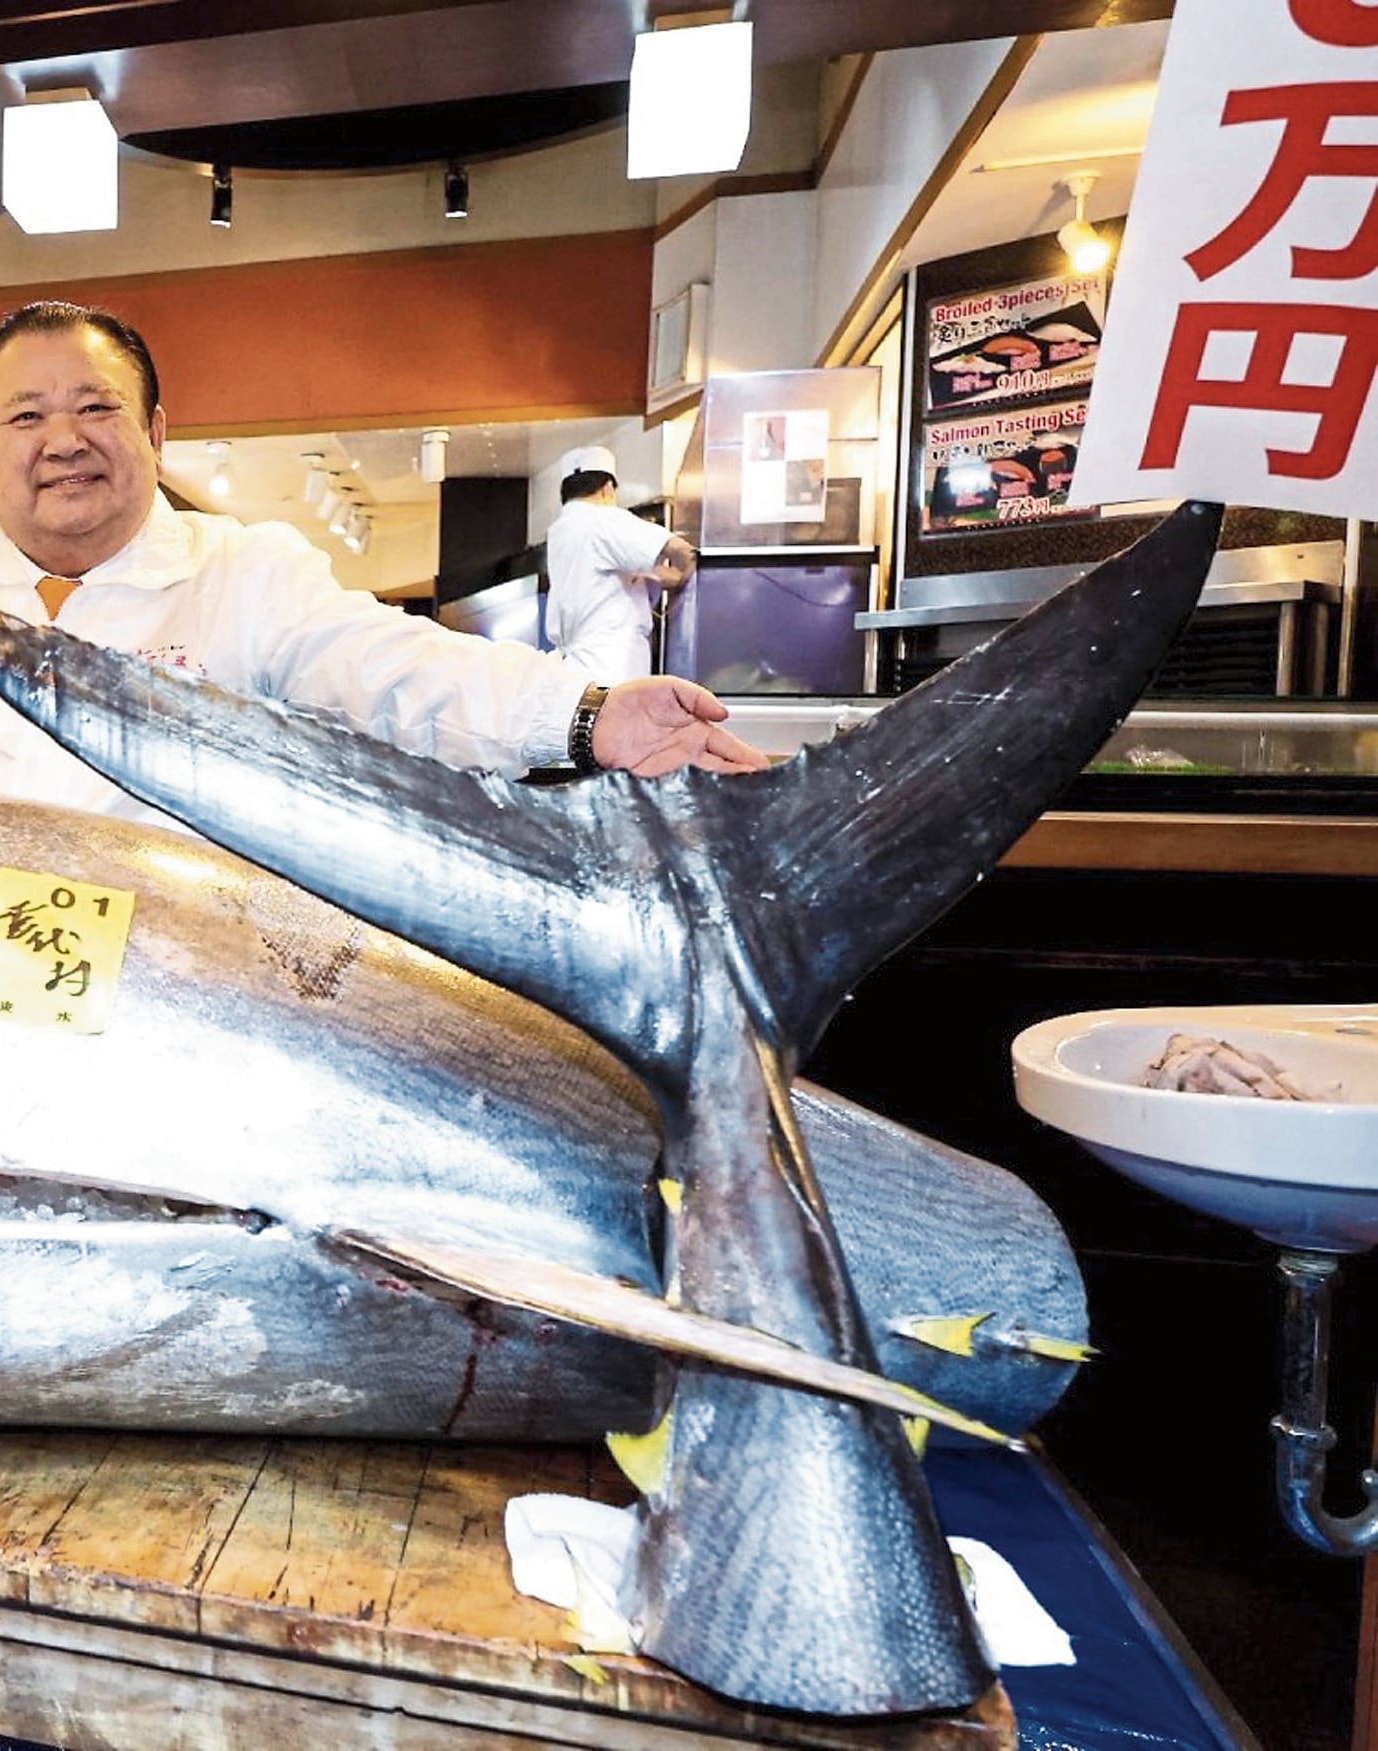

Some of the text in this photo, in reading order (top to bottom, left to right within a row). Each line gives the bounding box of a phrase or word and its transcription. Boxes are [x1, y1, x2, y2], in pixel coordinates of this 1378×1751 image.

[935, 300, 993, 323] Broiled
[931, 403, 1088, 445] Salmon Tasting Se
[51, 887, 110, 917] 01
